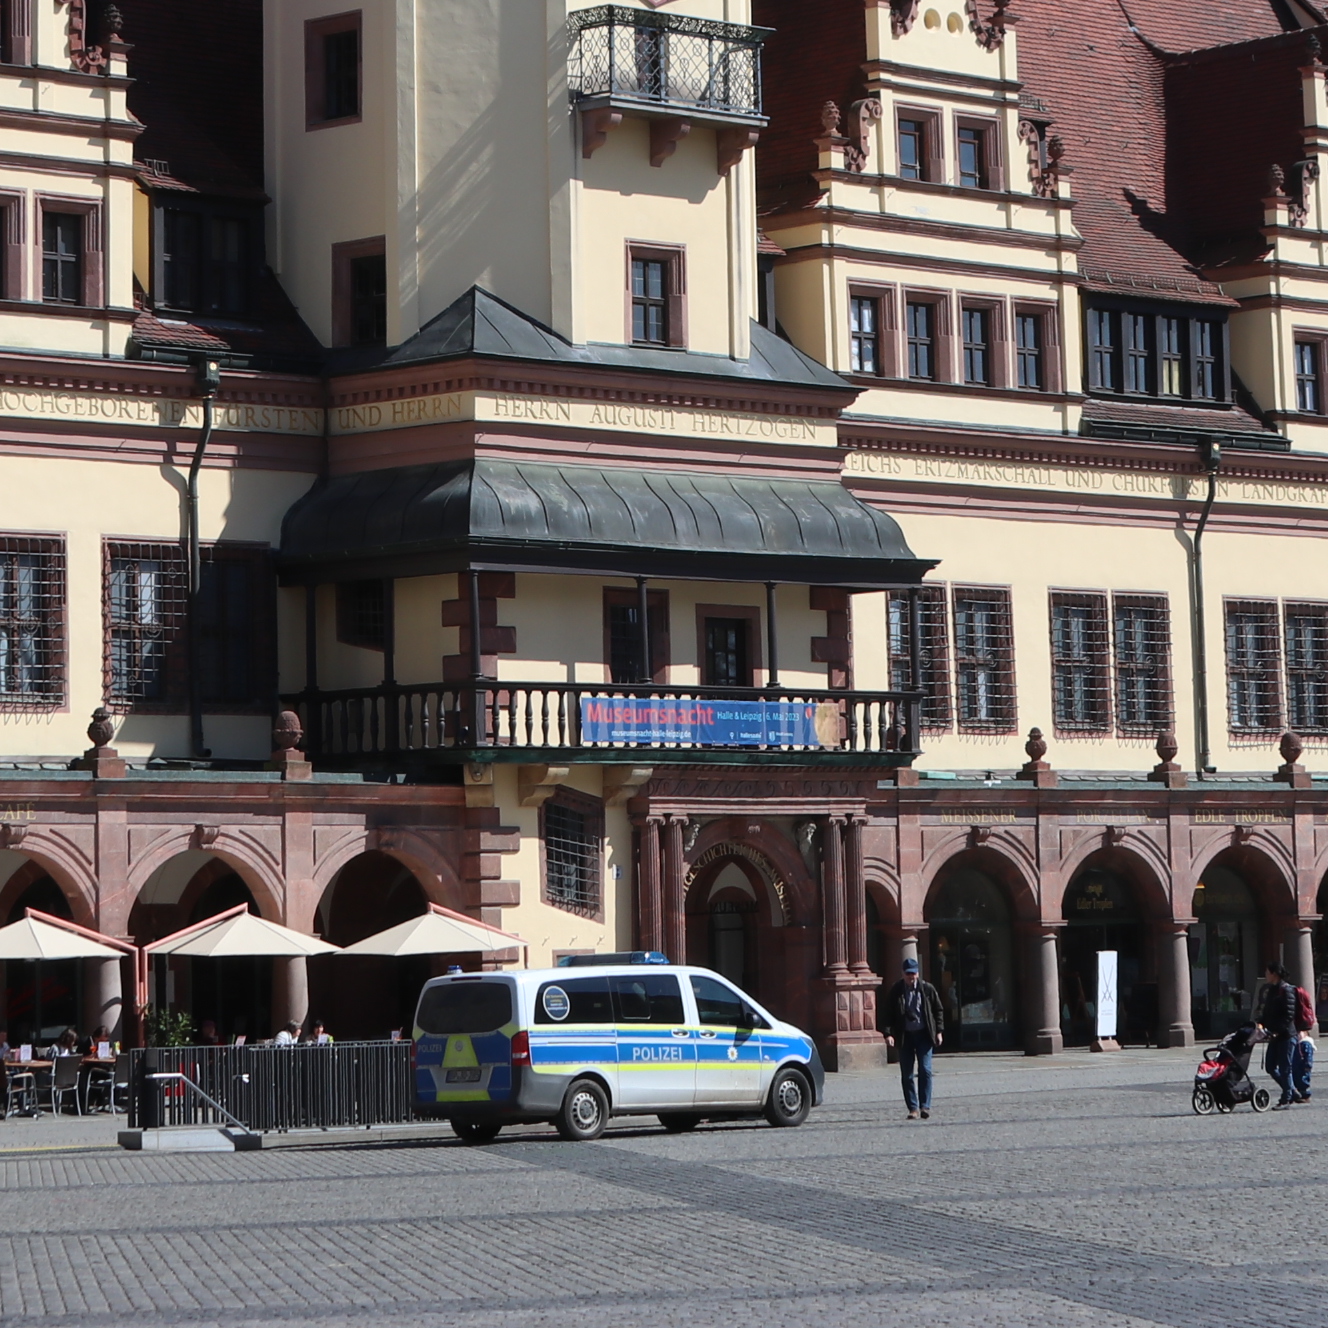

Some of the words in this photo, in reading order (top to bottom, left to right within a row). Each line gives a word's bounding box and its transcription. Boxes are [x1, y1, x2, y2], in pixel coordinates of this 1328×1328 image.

[213, 403, 320, 431] FÜRSTEN
[338, 404, 382, 430] UND
[391, 394, 462, 424] HERRN
[494, 394, 572, 422] HERRN
[589, 404, 676, 431] AUGUSTI
[691, 410, 817, 440] HERTZOGEN
[914, 457, 1056, 487] ERTZMARSCHALL
[1065, 469, 1102, 489] UND
[587, 703, 714, 725] Museumsnacht
[717, 711, 733, 720] Halle
[734, 712, 740, 720] &
[740, 712, 762, 722] Leipzig
[766, 712, 772, 721] 6.
[773, 713, 784, 721] Mai
[785, 713, 800, 722] 2023
[940, 808, 1017, 824] MEISSENER
[1076, 808, 1152, 824] PORZELLAN
[1194, 808, 1226, 824] EDLE
[1233, 808, 1289, 823] TROPFEN
[418, 1044, 442, 1052] POLIZEI
[632, 1046, 683, 1061] POLIZEI
